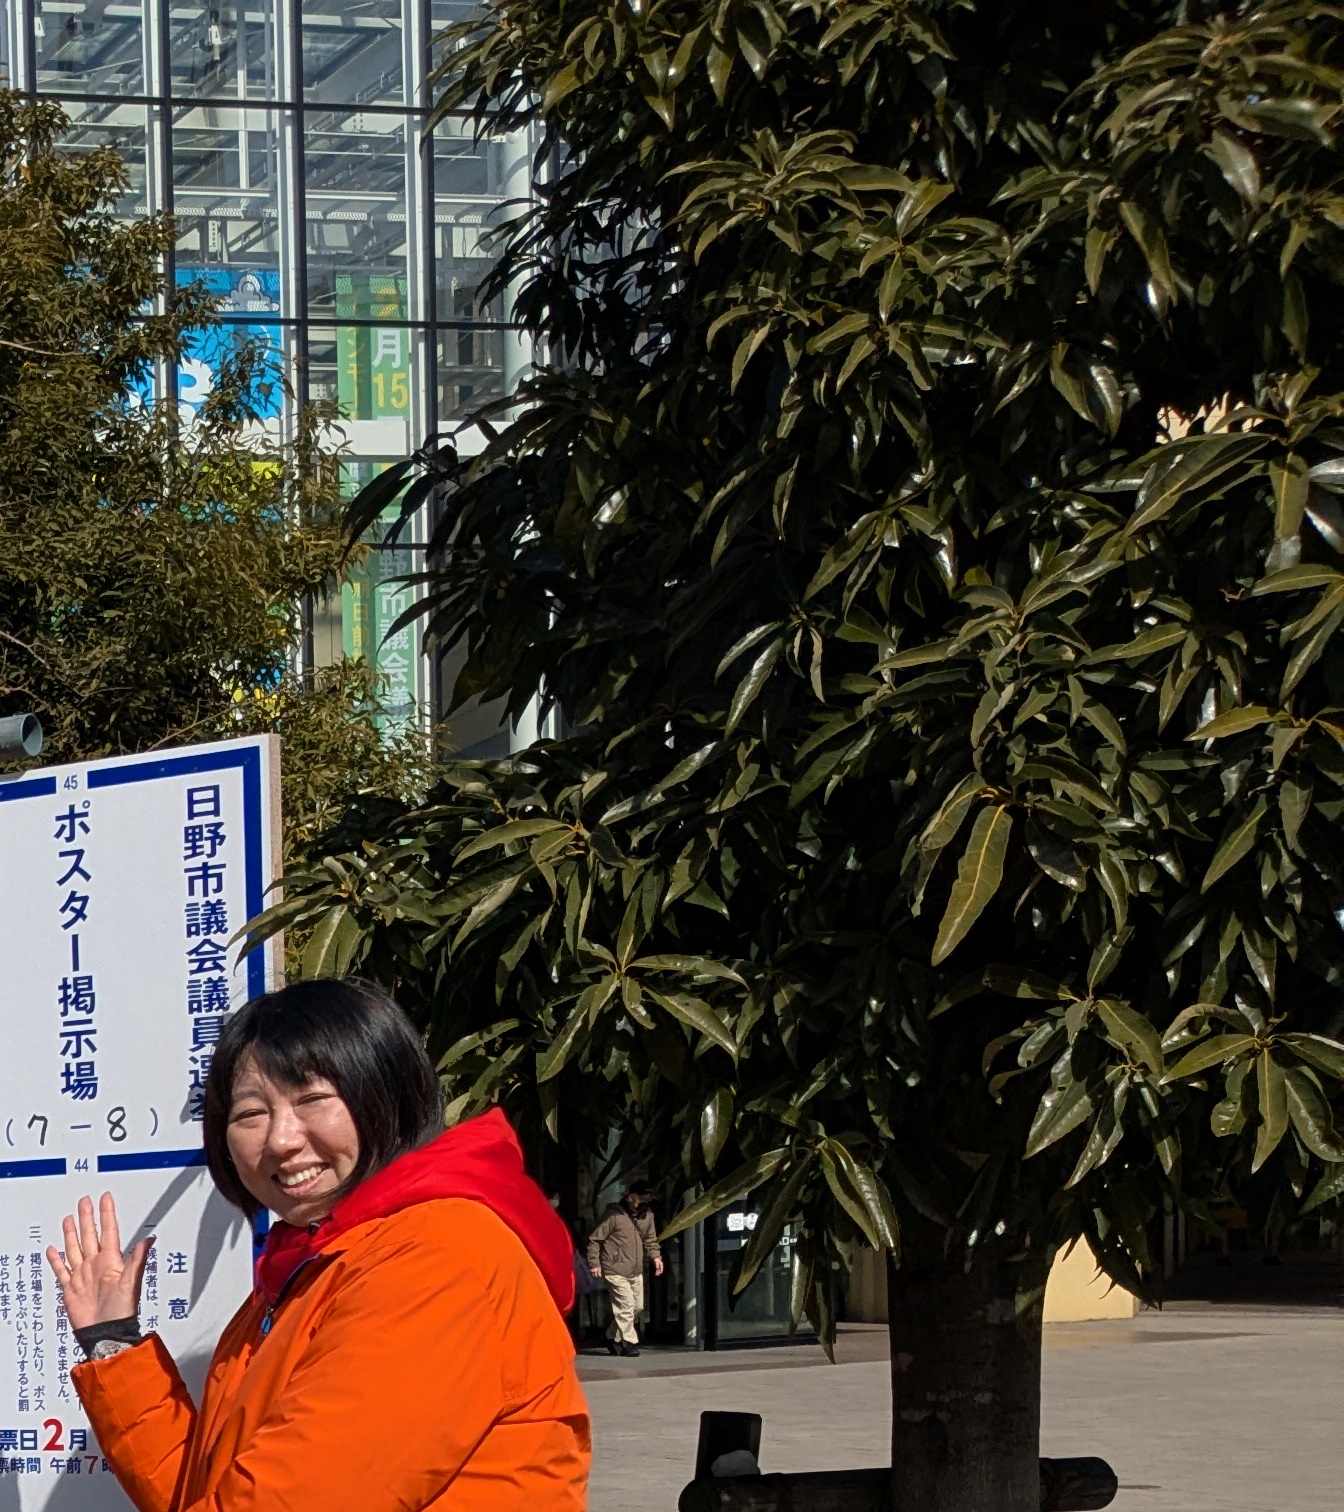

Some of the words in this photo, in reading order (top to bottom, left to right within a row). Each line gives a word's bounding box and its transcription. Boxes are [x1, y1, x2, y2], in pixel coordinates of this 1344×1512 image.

[63, 776, 79, 790] 45
[53, 799, 99, 1102] ポスター掲示場
[74, 1158, 90, 1173] 44
